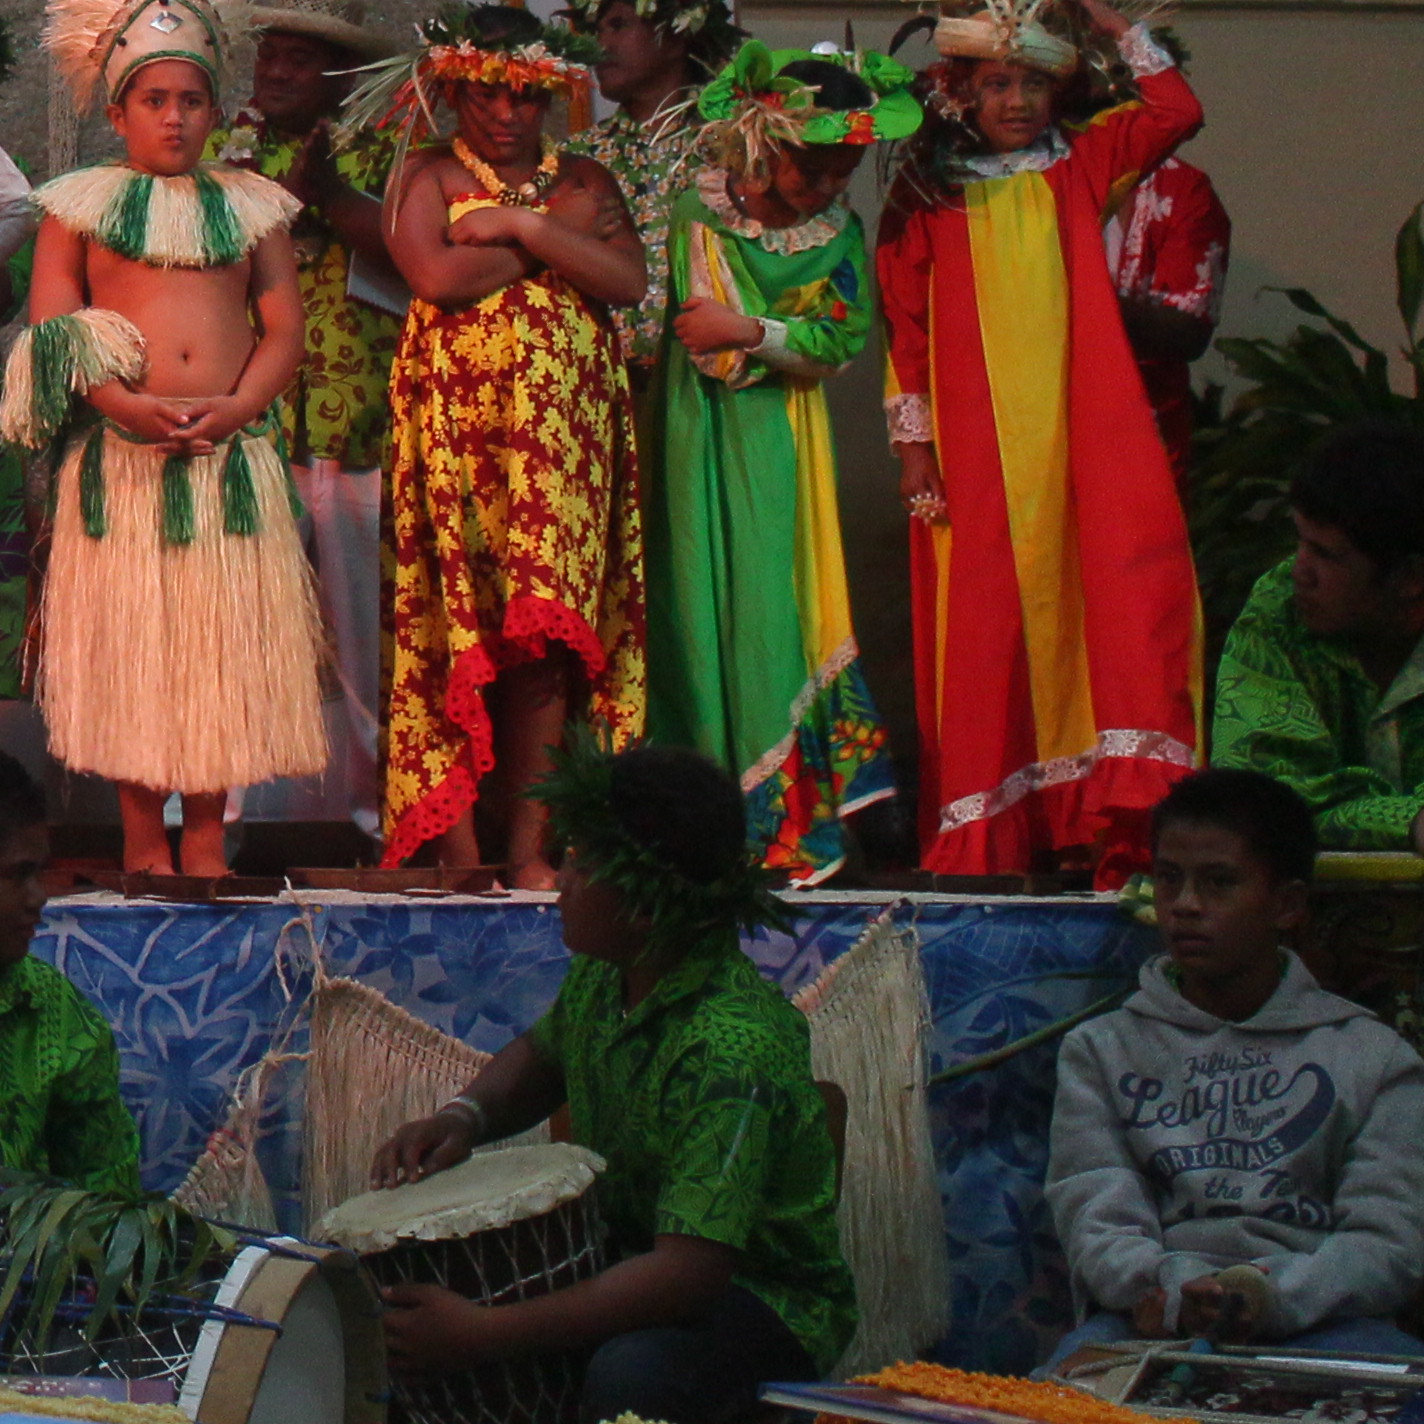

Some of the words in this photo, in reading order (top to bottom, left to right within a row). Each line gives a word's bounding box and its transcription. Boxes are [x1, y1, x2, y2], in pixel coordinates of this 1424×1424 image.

[1119, 1068, 1283, 1136] League
[1156, 1139, 1283, 1175] ORIGINALS
[1205, 1177, 1243, 1200] the
